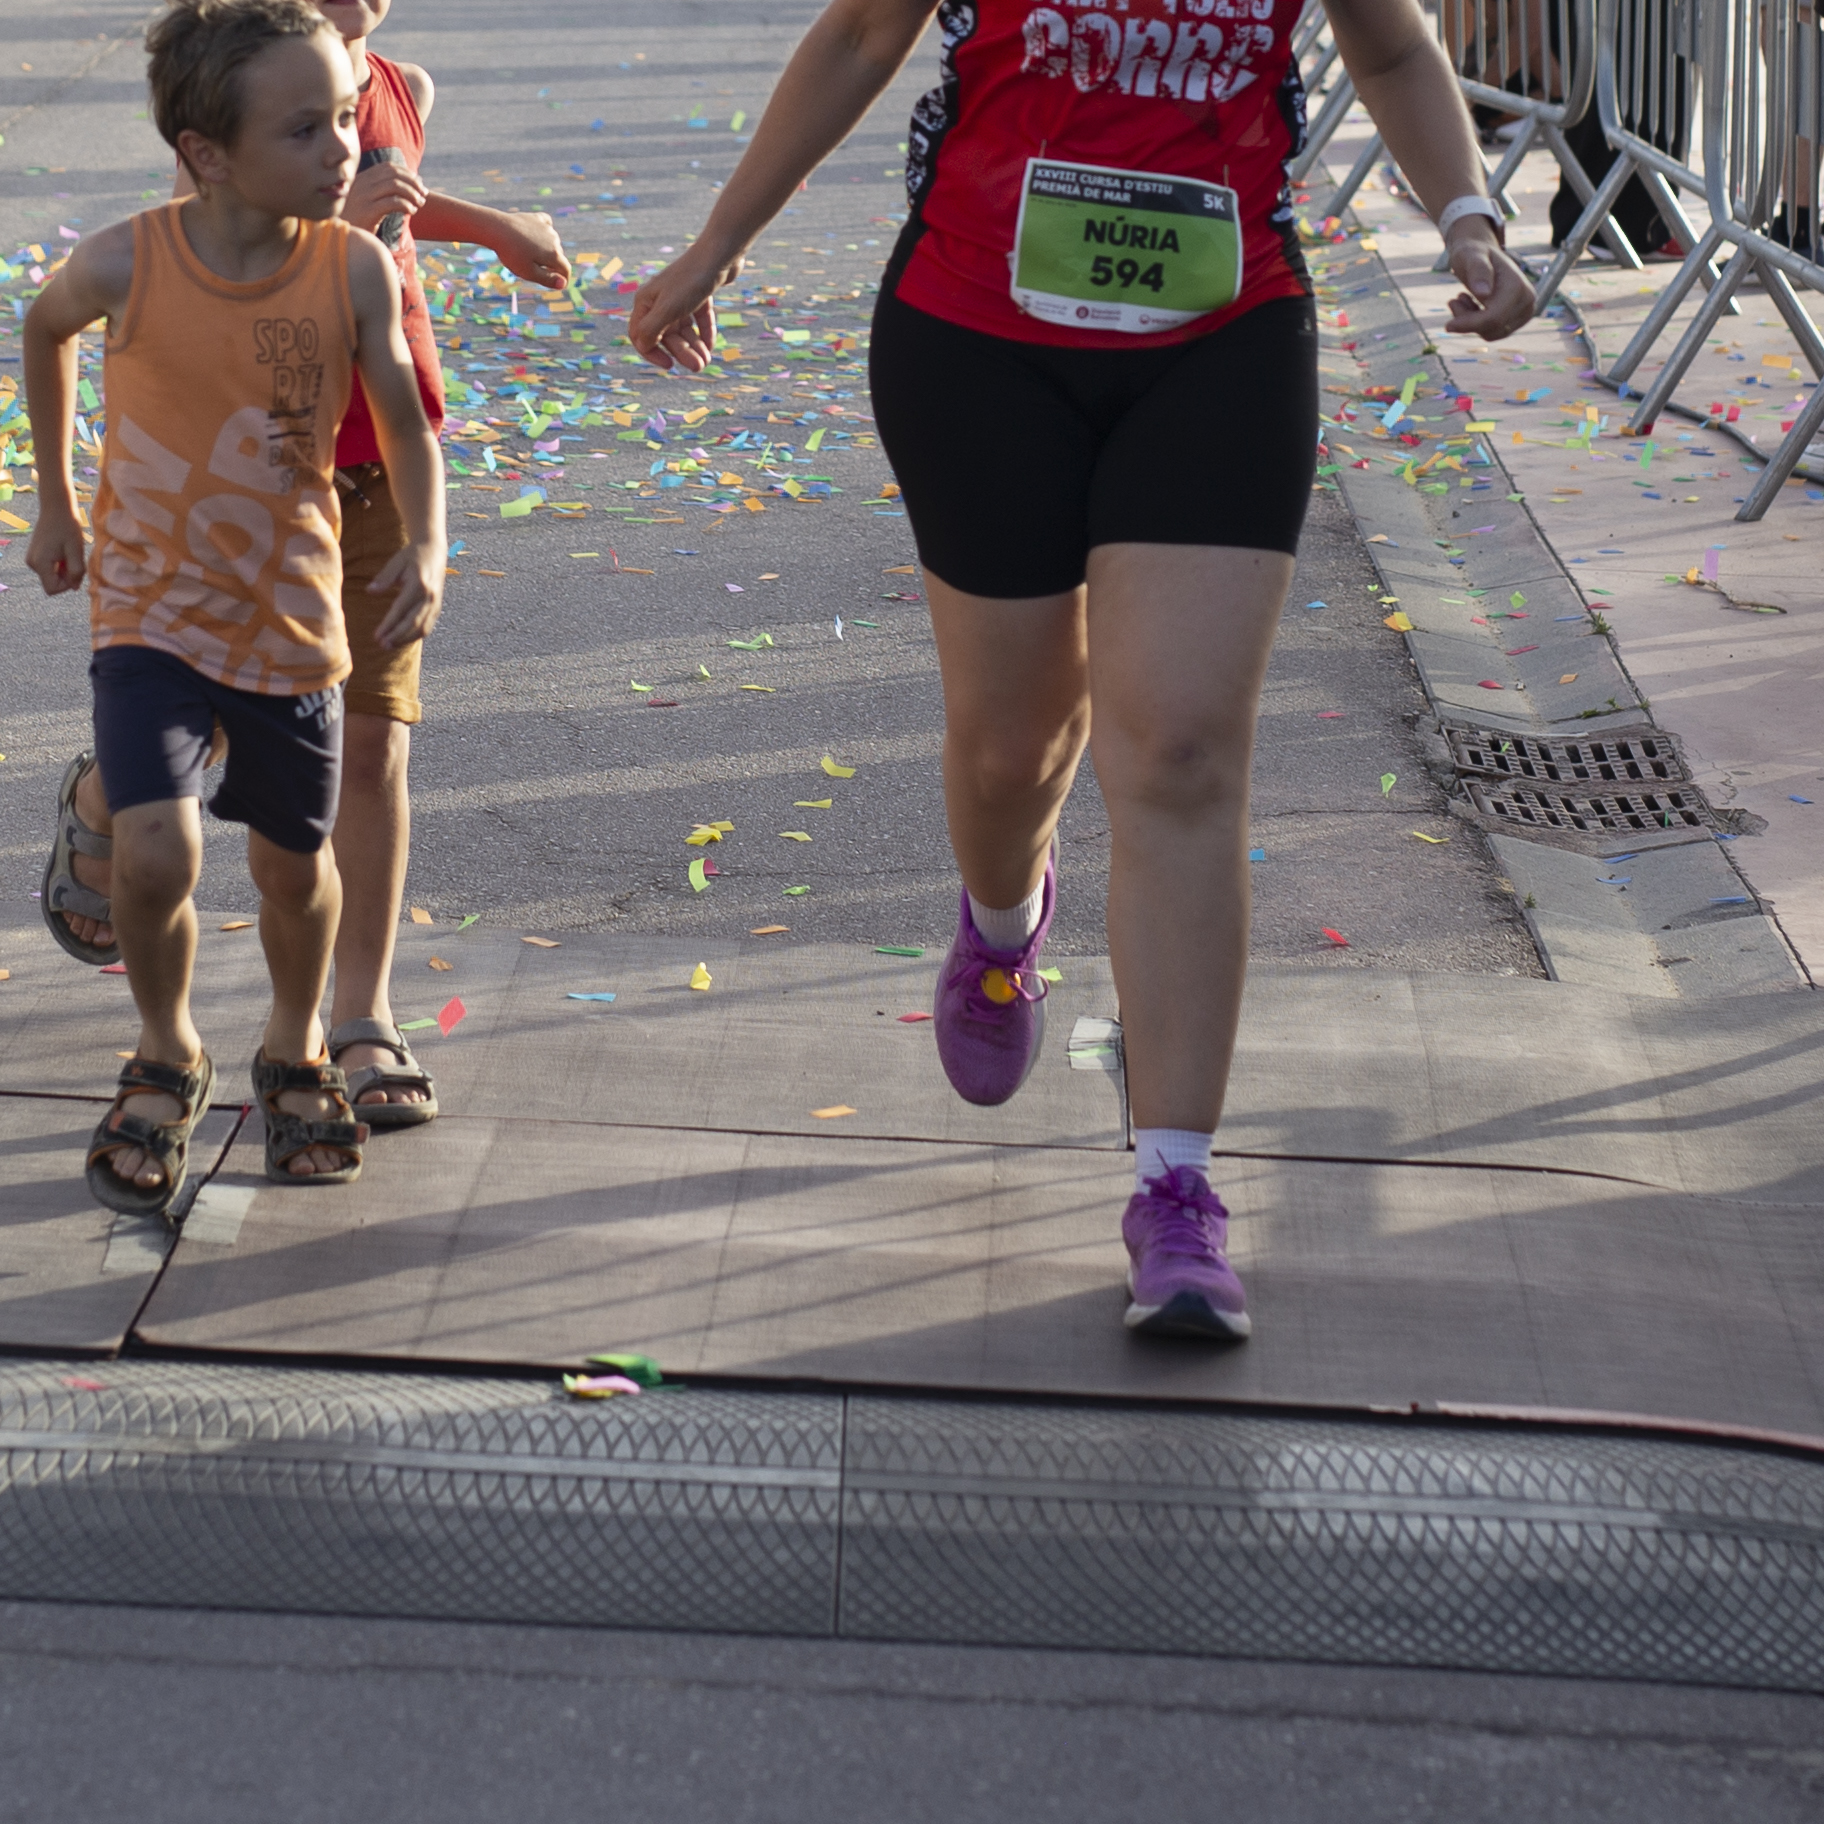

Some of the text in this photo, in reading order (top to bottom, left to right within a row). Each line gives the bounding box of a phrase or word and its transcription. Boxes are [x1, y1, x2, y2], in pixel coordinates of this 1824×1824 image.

[1032, 179, 1131, 203] PREMIÀ DE MAR
[1079, 173, 1121, 189] CURSA
[1124, 179, 1173, 195] D'ESTIU
[1203, 193, 1226, 212] 5K
[1083, 215, 1181, 254] NÚRIA
[1089, 254, 1166, 293] 594
